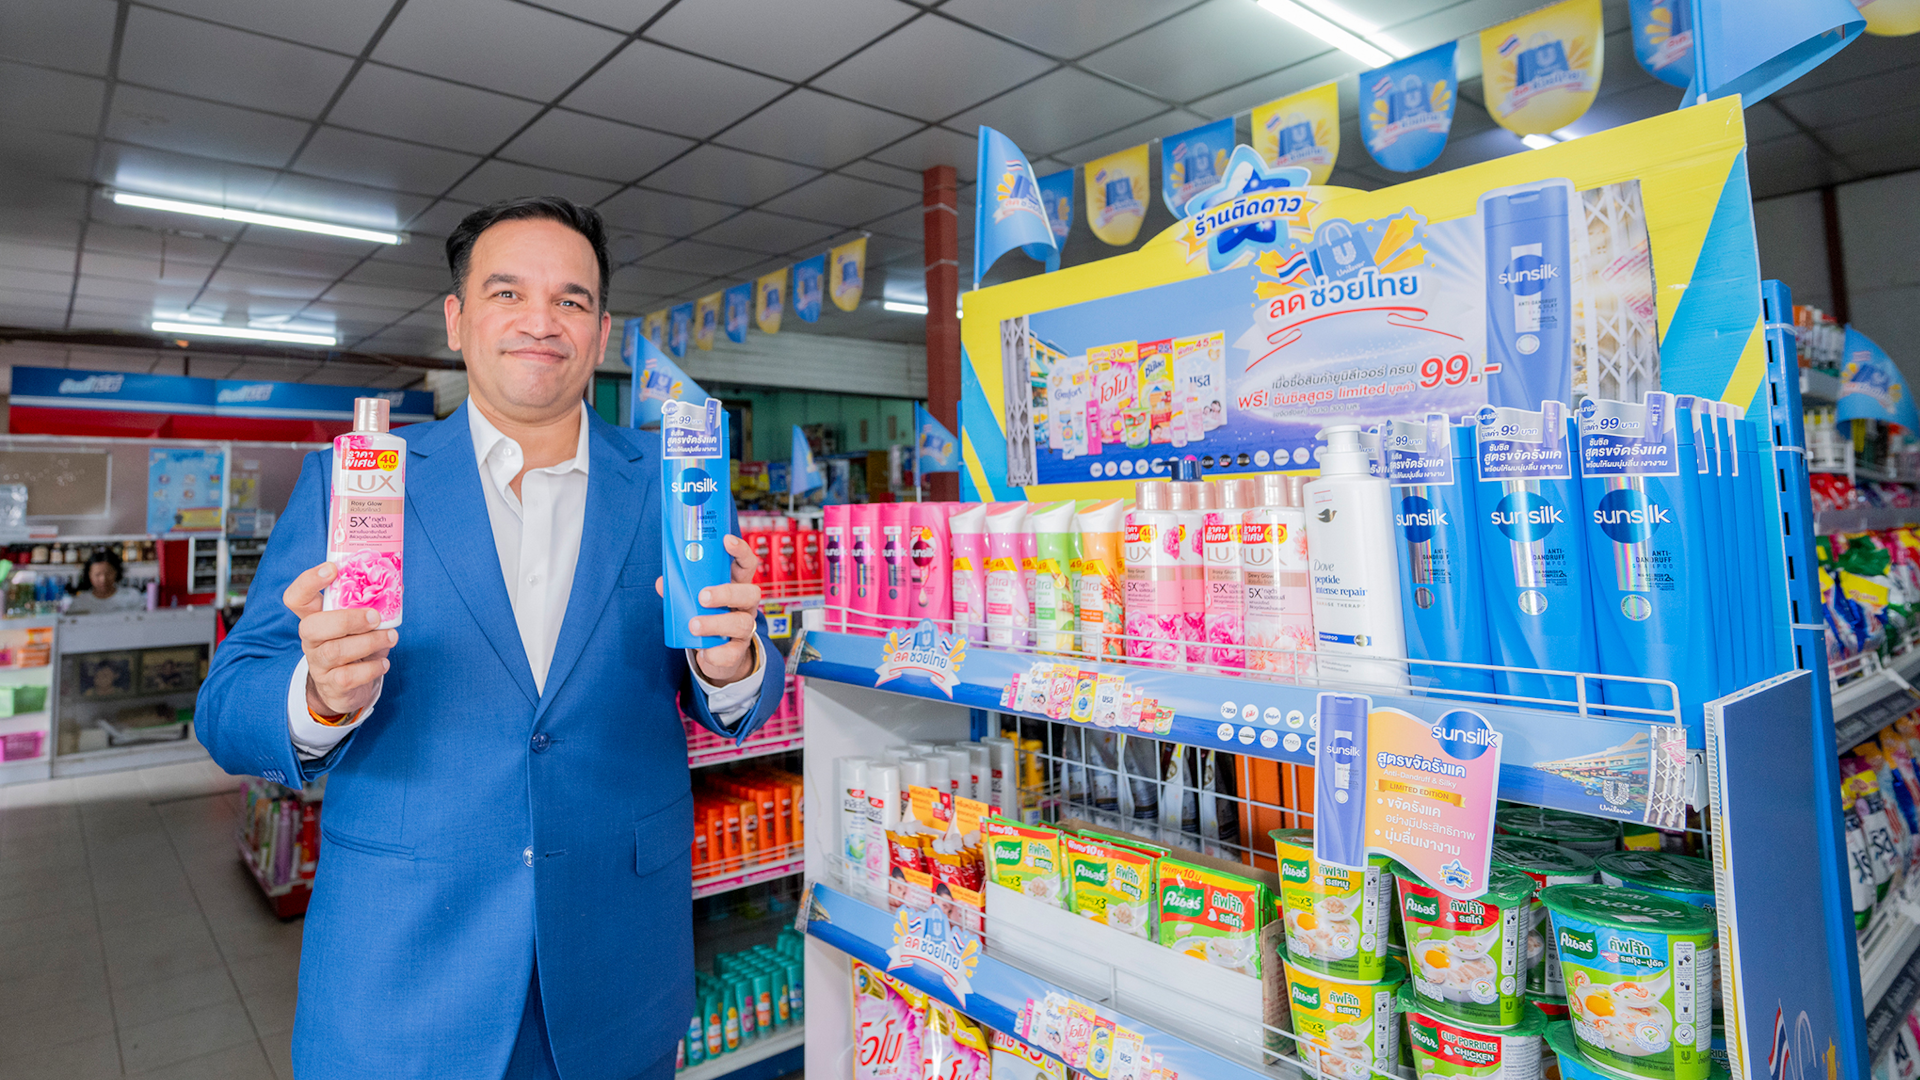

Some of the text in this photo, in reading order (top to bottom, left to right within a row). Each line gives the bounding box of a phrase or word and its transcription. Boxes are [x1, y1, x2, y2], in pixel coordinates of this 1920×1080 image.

[1195, 196, 1302, 237] ร้านติดดาว
[1336, 260, 1366, 277] Unilever
[1498, 263, 1560, 285] sunsilk
[1269, 269, 1418, 319] ลด ช่วยไทย
[1196, 336, 1209, 348] 45
[1389, 363, 1415, 377] ครบ
[1420, 354, 1500, 388] 99.-
[1101, 373, 1128, 404] โอโม
[1238, 381, 1416, 409] ฟรี! ซันซิลสูตร limited มูลค่า
[679, 415, 691, 425] 99
[1600, 417, 1620, 430] 99
[1501, 425, 1519, 436] 99
[1521, 428, 1538, 436] บาท
[667, 435, 717, 448] สูตรขจัดรังแค
[1395, 435, 1409, 446] 99
[348, 450, 374, 458] ราคา
[380, 454, 397, 464] 40
[1484, 449, 1562, 466] สูตรขจัดรังแค
[1585, 444, 1667, 461] สูตรขจัดรังแค
[344, 457, 376, 468] พิเศษ
[344, 474, 397, 494] LUX
[671, 477, 718, 493] sunsilk
[350, 516, 369, 528] 5X
[1396, 508, 1449, 527] sunsilk
[1490, 505, 1565, 525] sunsilk
[1593, 504, 1672, 525] sunsilk
[1141, 528, 1155, 537] 40
[1205, 533, 1229, 541] พิเศษ
[1266, 528, 1285, 538] 40
[1243, 548, 1288, 567] LUX
[1313, 559, 1335, 572] Dove
[1085, 562, 1095, 571] 49
[1314, 575, 1341, 585] peptide
[1315, 586, 1366, 598] intense repair
[893, 647, 948, 669] ลด ช่วยไทย
[1053, 682, 1071, 696] โอโม
[1261, 735, 1277, 743] Citra
[1431, 725, 1498, 748] sunsilk
[1326, 745, 1361, 757] sunsilk
[1376, 752, 1467, 778] สูตรขจัดรังแค
[1383, 769, 1431, 783] Anti-Dandruff
[1438, 778, 1457, 789] Silky
[1389, 782, 1449, 800] LIMITED EDITION
[1387, 797, 1441, 818] ขจัดรังแค
[1599, 803, 1634, 816] Unilever
[1385, 814, 1476, 841] อย่างมีประสิทธิภาพ
[1385, 828, 1461, 856] นุ่มลื่นเงางาม
[995, 845, 1021, 860] คนอร์
[1075, 863, 1139, 886] คนอร์ คัพโจ๊ก
[1162, 863, 1183, 876] พิเศษ
[1183, 868, 1195, 879] 10
[1282, 862, 1308, 878] คนอร์
[1325, 877, 1350, 891] รสหมู
[1163, 890, 1244, 914] คนอร์ คัพโจ๊ก
[1406, 897, 1485, 916] คนอร์ คัพโจ๊ก
[1459, 914, 1483, 925] รสไก่
[1560, 932, 1651, 957] คนอร์ คัพโจ๊ก
[904, 936, 960, 970] ลด ช่วยไทย
[1292, 986, 1360, 1006] คนอร์ คัพโจ๊ก
[1337, 1005, 1361, 1018] รสหมู
[1068, 1024, 1087, 1039] โอโม
[1410, 1024, 1498, 1053] Knorr CUP PORRIDGE
[1454, 1046, 1495, 1062] CHICKEN
[1462, 1055, 1487, 1065] FLAVOUR
